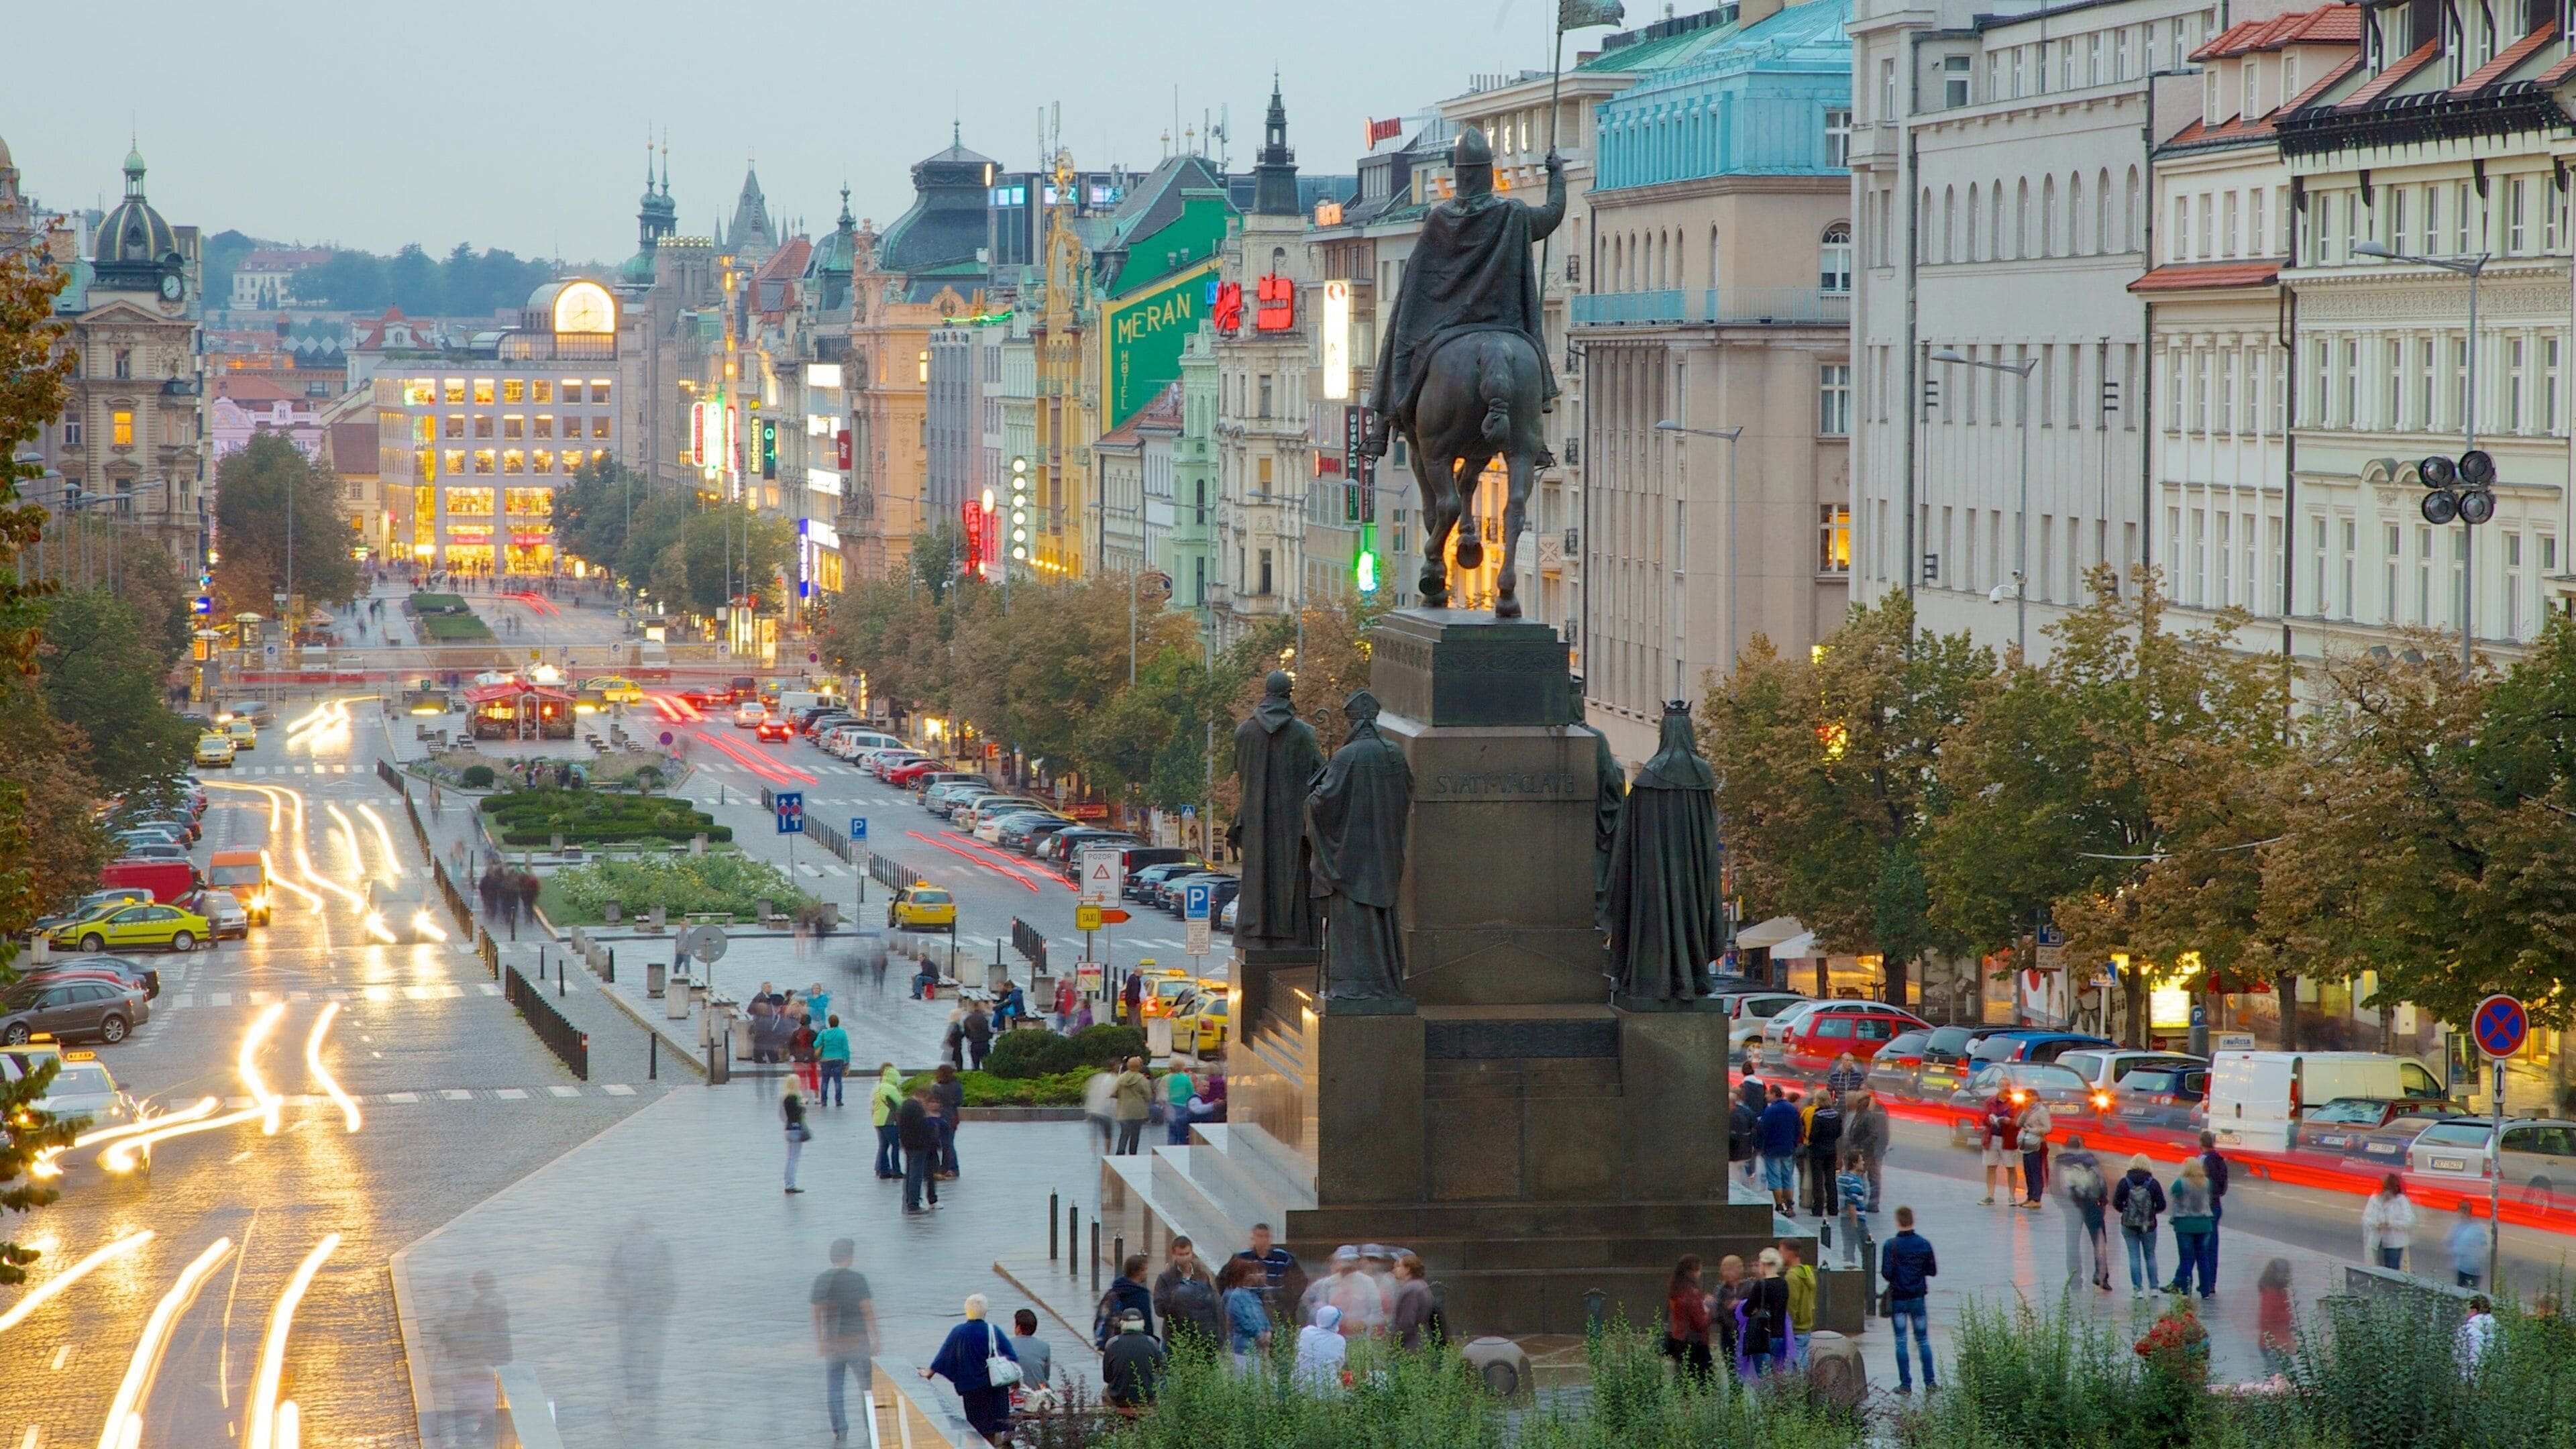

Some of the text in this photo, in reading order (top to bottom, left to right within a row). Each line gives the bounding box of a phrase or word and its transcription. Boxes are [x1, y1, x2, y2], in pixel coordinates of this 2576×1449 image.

[1118, 293, 1191, 343] MERAN
[1121, 350, 1129, 410] HOTEL
[751, 418, 760, 472] McDonald's
[1348, 413, 1358, 468] Elysee
[854, 820, 863, 833] P
[1190, 889, 1205, 909] P
[1082, 913, 1097, 922] TAXI
[2194, 1011, 2202, 1021] P
